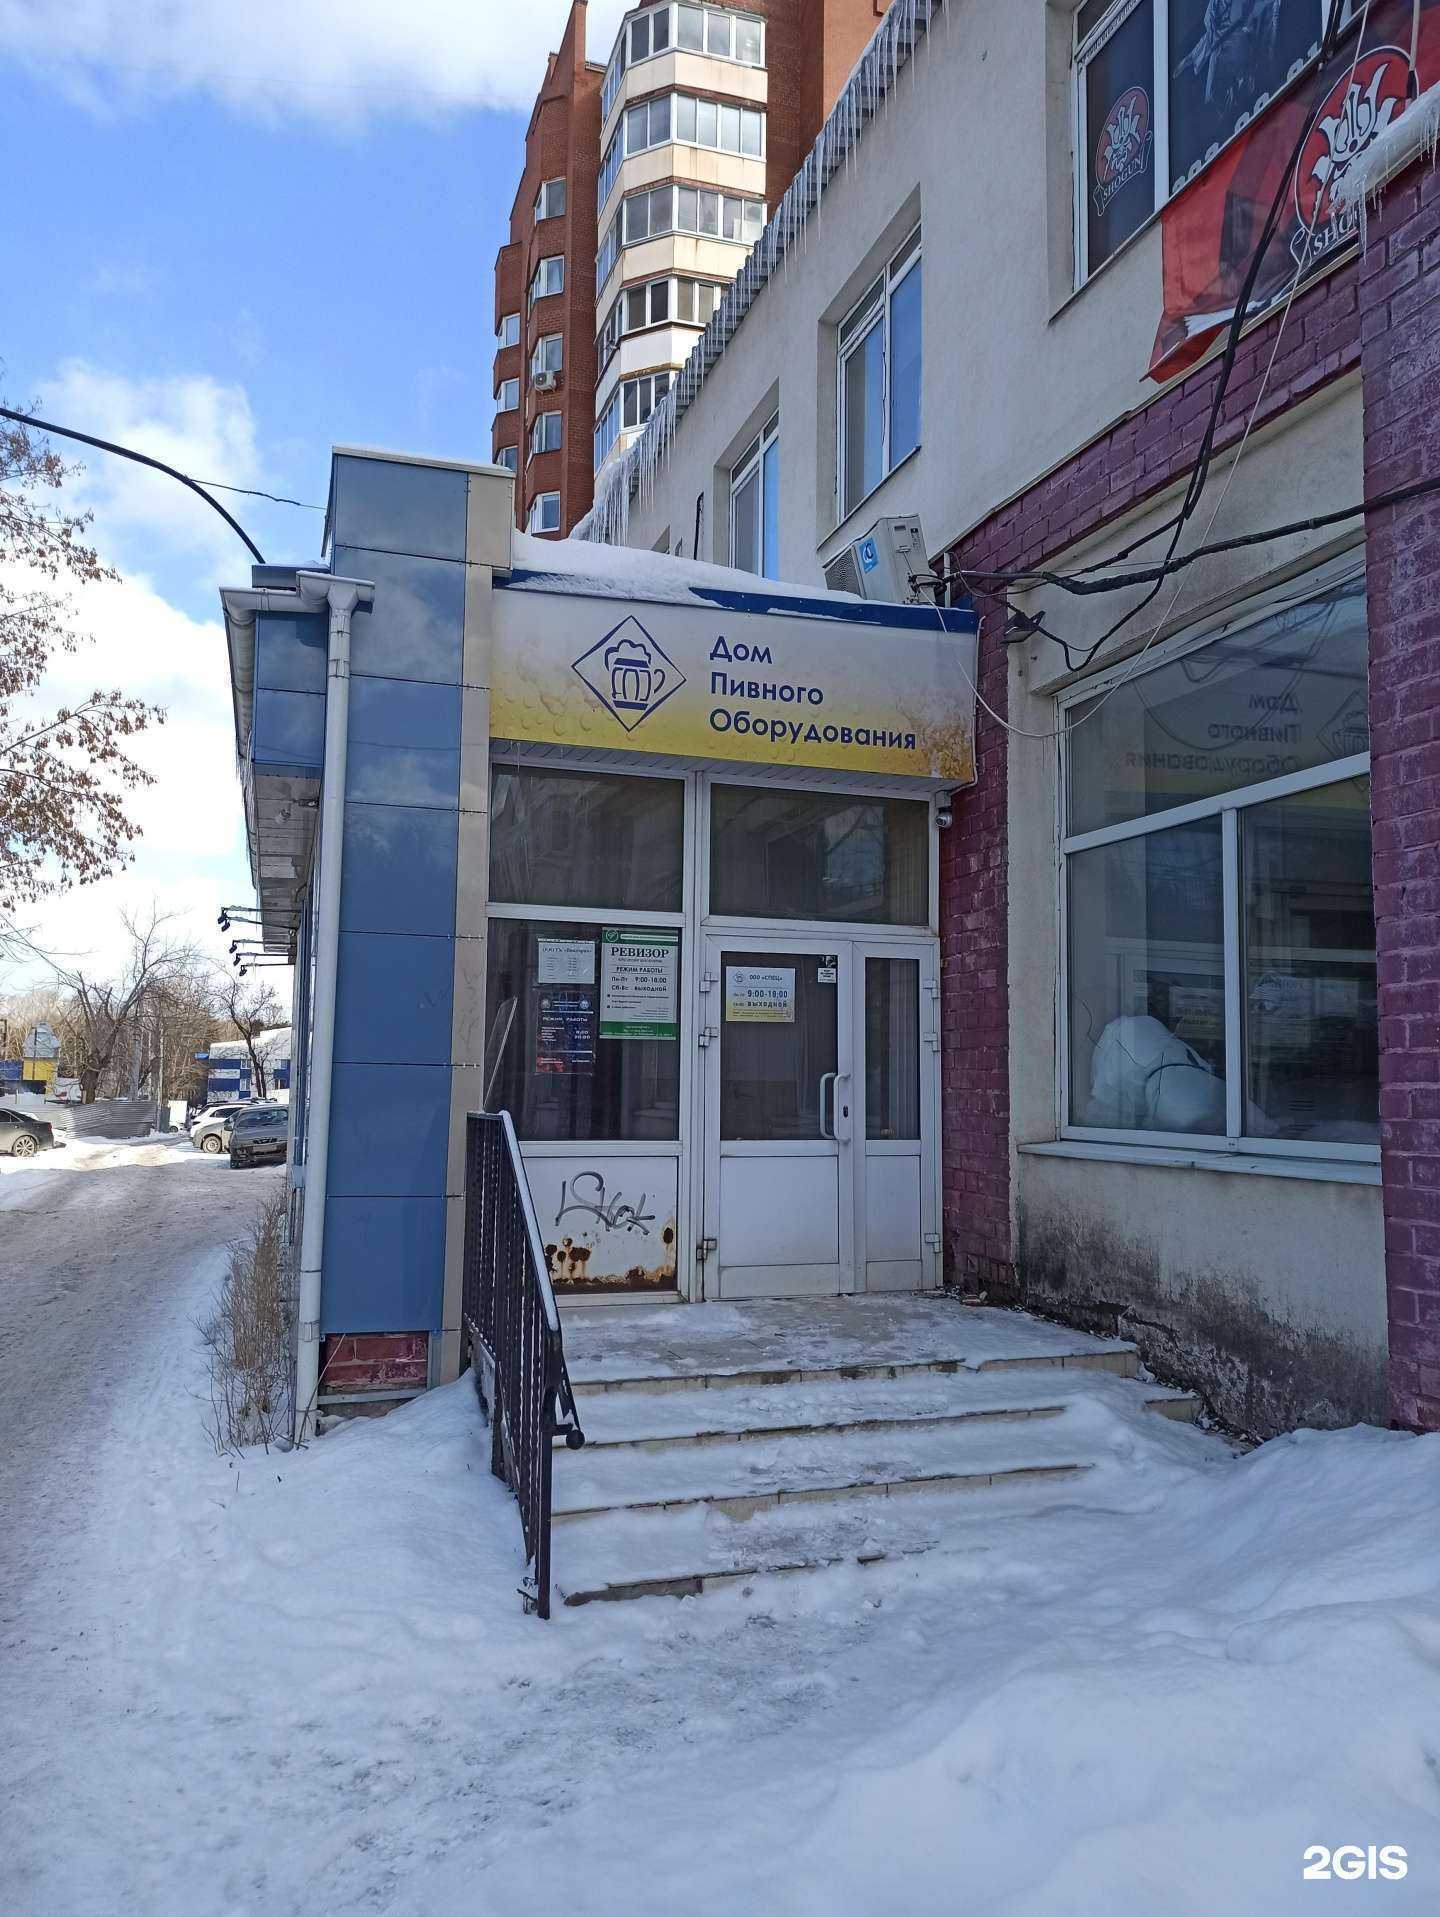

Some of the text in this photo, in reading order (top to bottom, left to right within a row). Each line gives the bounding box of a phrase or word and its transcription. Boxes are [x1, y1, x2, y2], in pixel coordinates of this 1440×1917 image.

[1103, 157, 1143, 201] SHOGUN
[710, 635, 773, 665] Дом
[711, 671, 824, 705] Пивного
[709, 708, 916, 750] Оборудования
[611, 946, 669, 958] РЕВИЗОР
